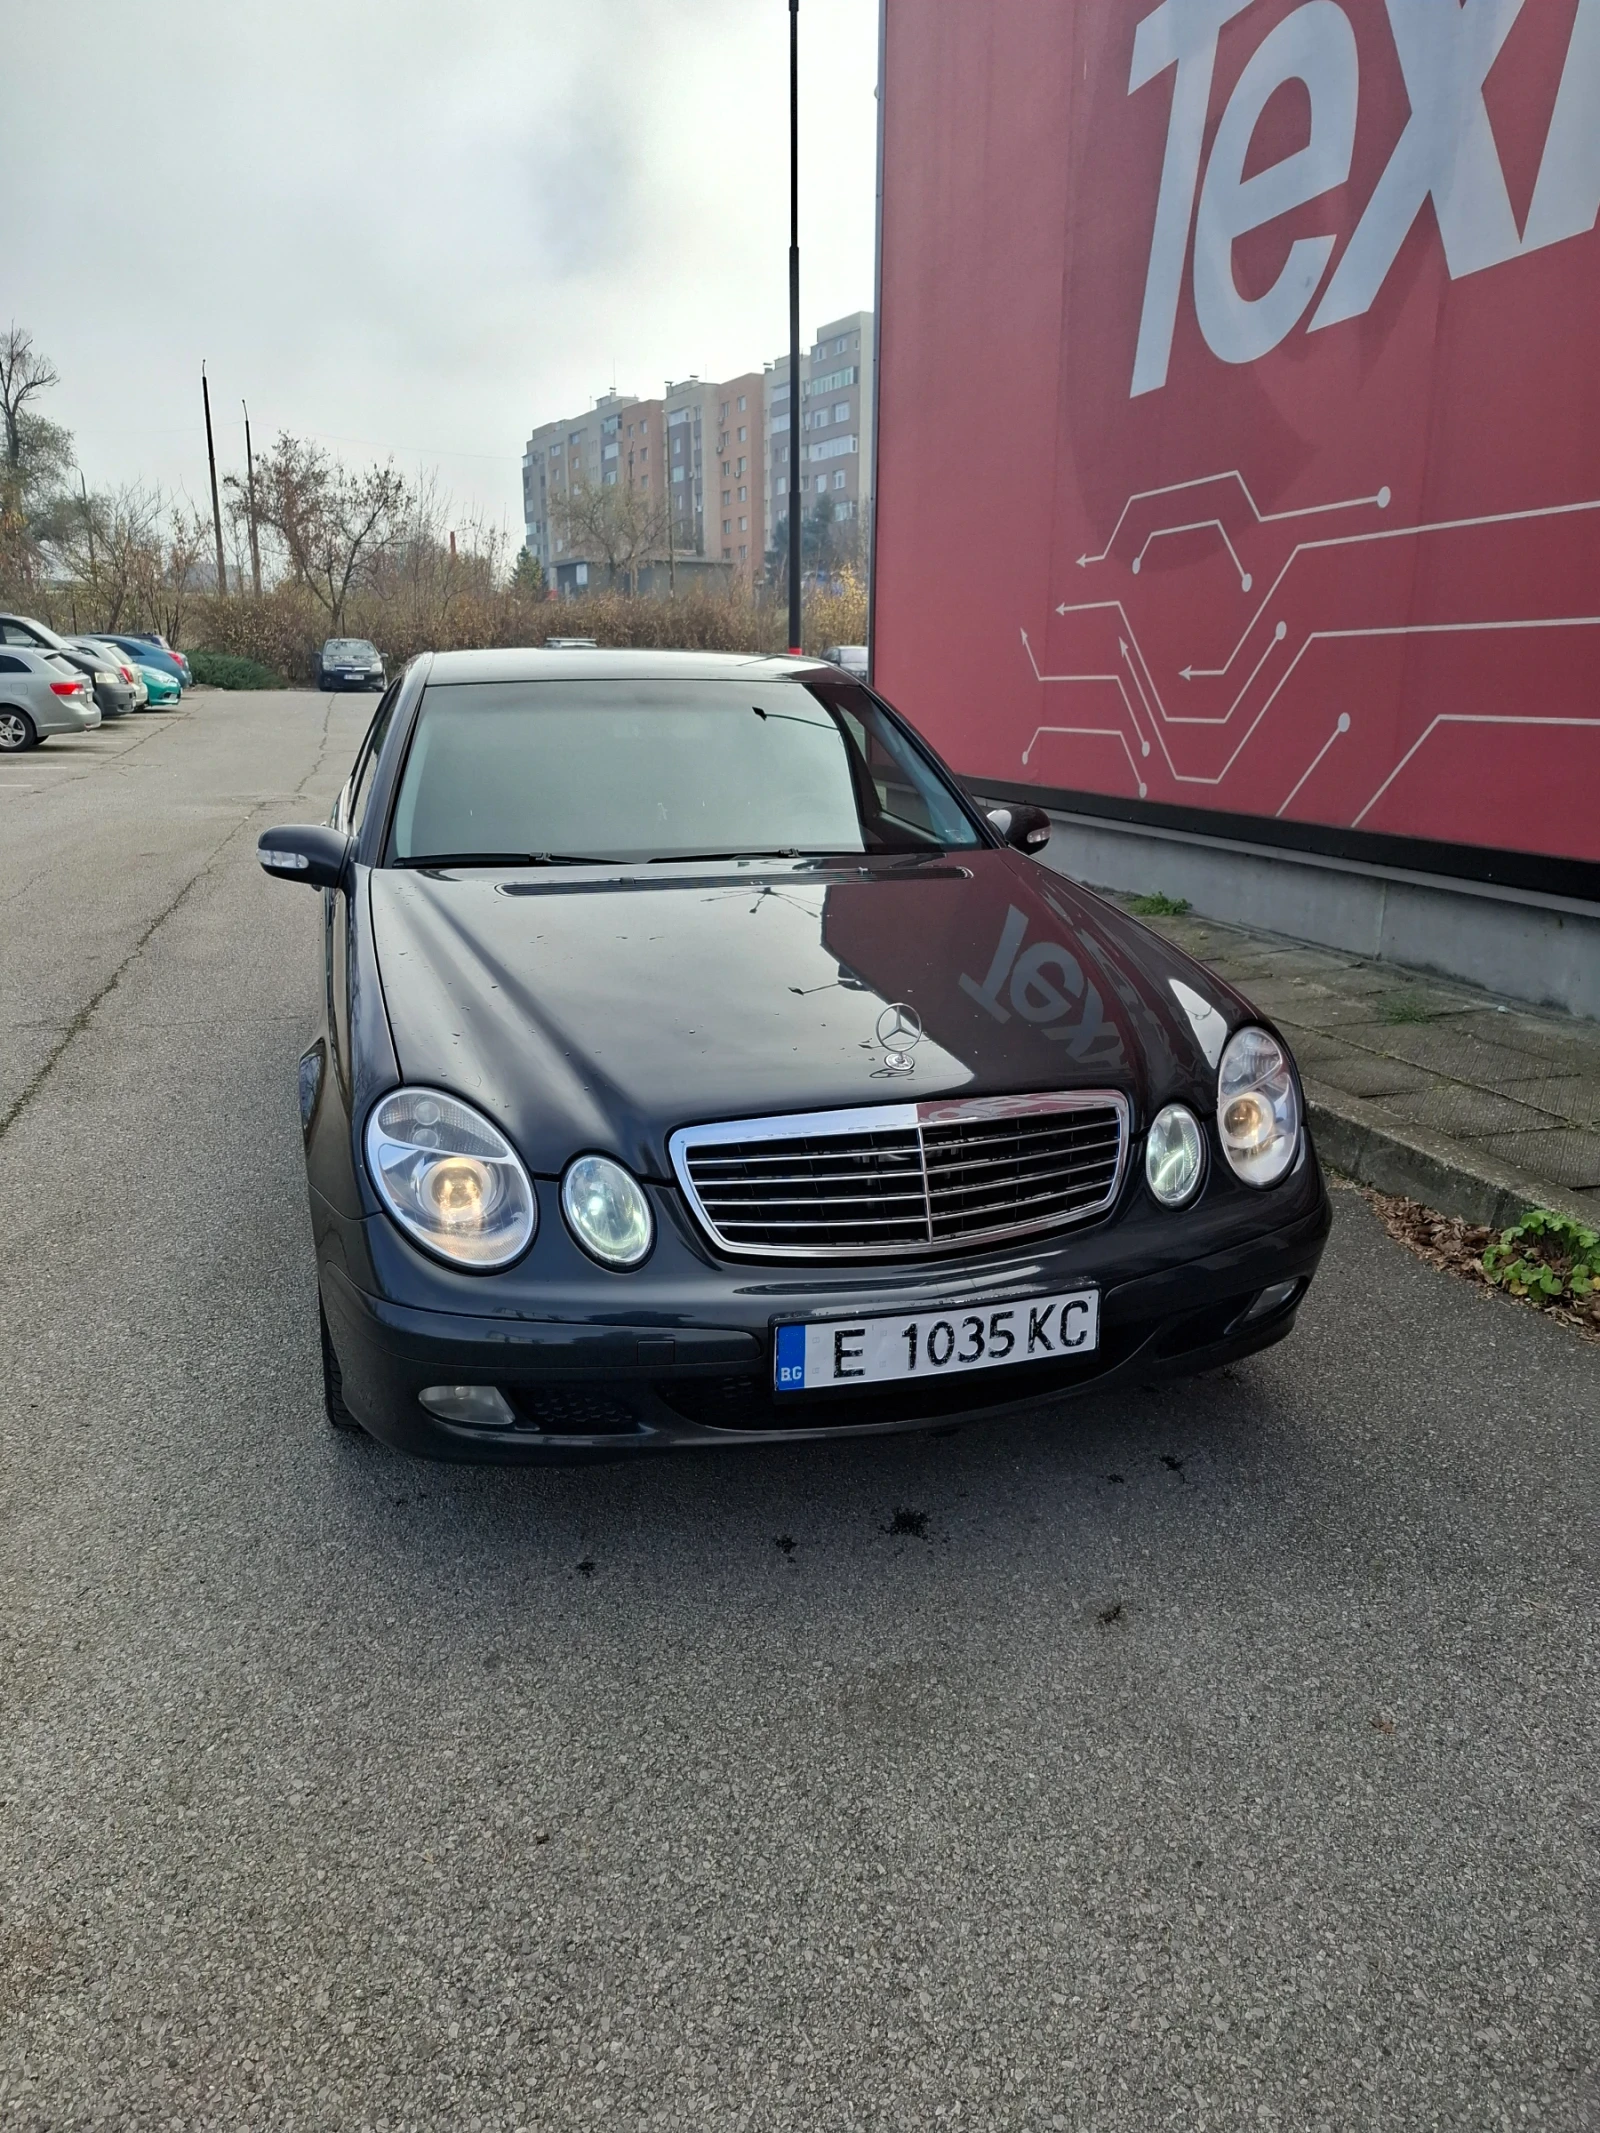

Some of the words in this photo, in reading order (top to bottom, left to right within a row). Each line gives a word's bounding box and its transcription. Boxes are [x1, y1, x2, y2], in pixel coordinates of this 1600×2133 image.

[833, 1328, 866, 1378] E
[901, 1310, 1016, 1371] 1035
[1027, 1299, 1090, 1354] KC
[780, 1365, 803, 1382] BG
